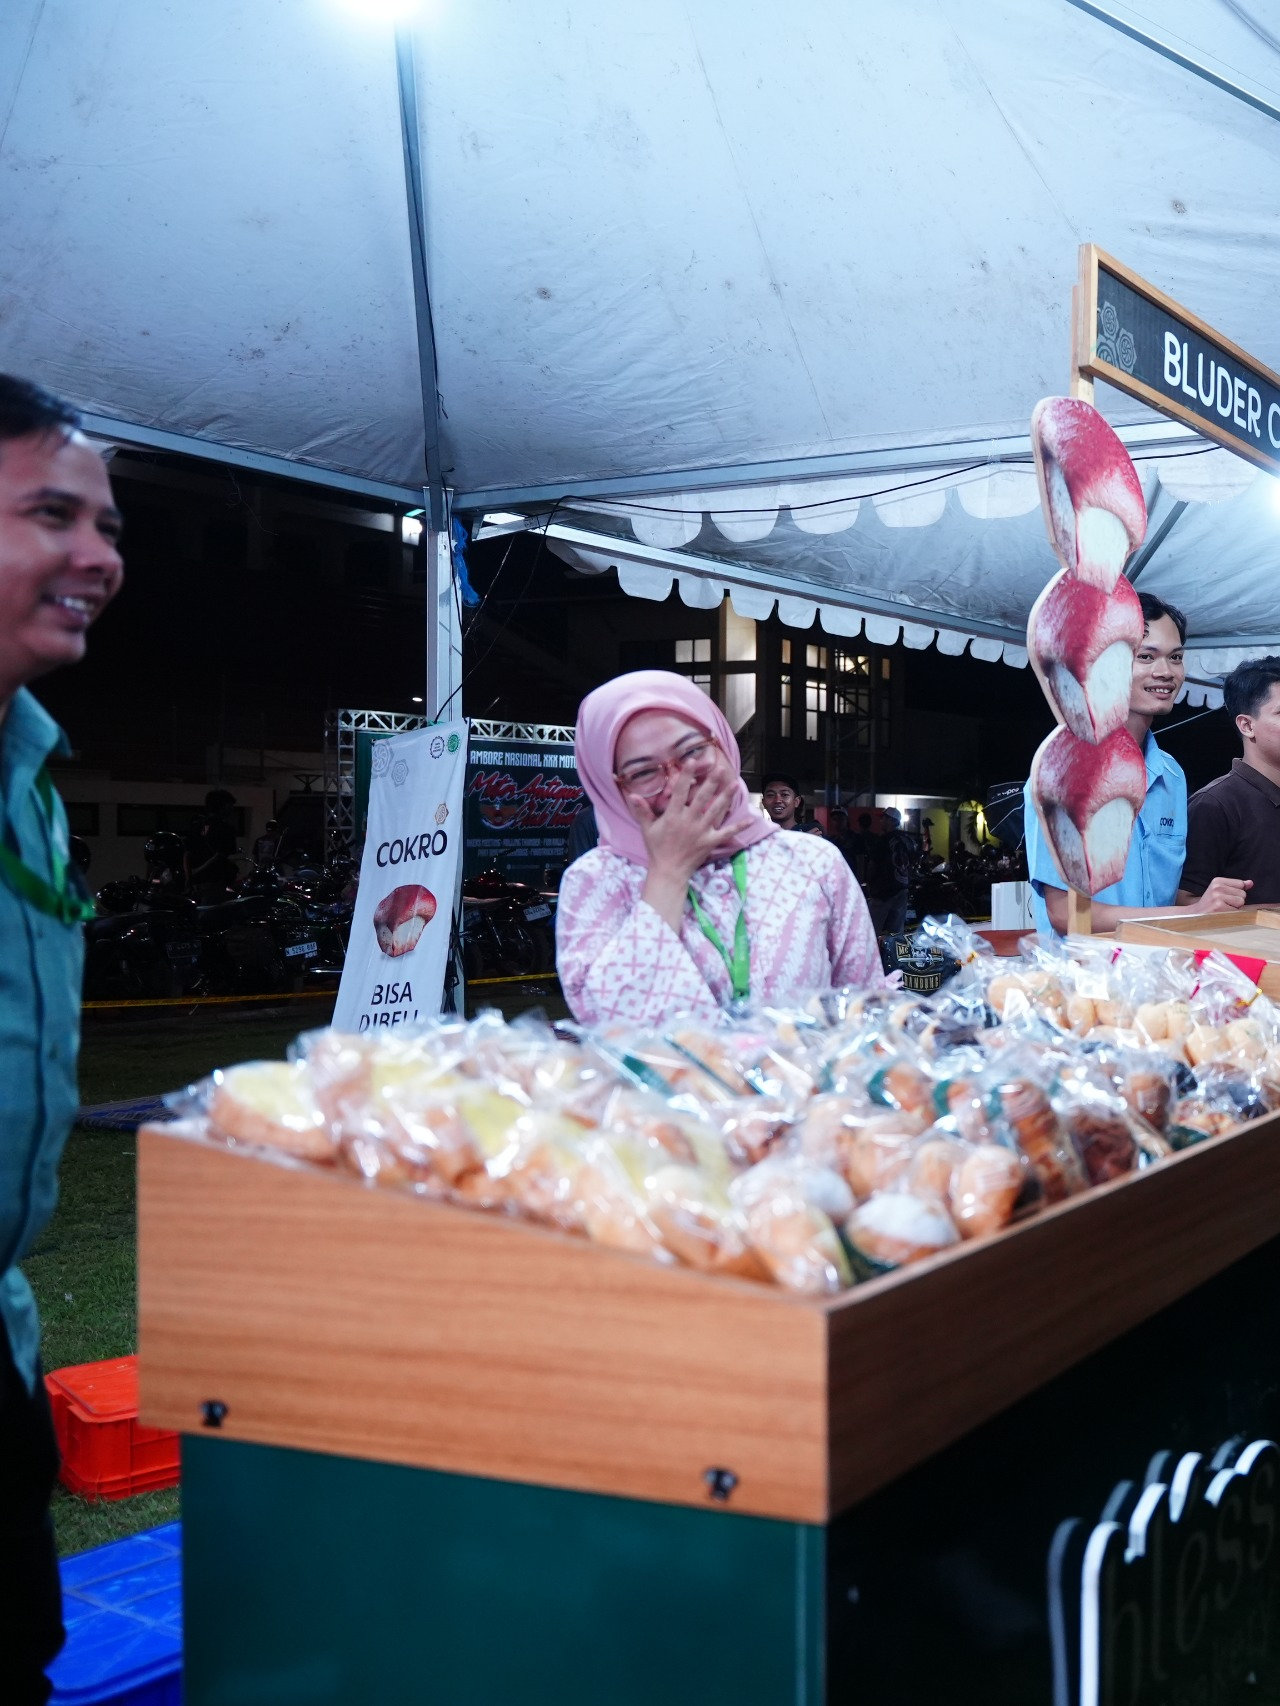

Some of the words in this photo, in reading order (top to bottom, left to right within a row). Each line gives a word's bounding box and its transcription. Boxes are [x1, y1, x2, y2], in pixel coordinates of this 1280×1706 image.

[1163, 331, 1262, 438] BLUDER
[505, 752, 542, 767] NASIONAL
[376, 829, 448, 868] COKRO
[371, 981, 413, 1006] BISA
